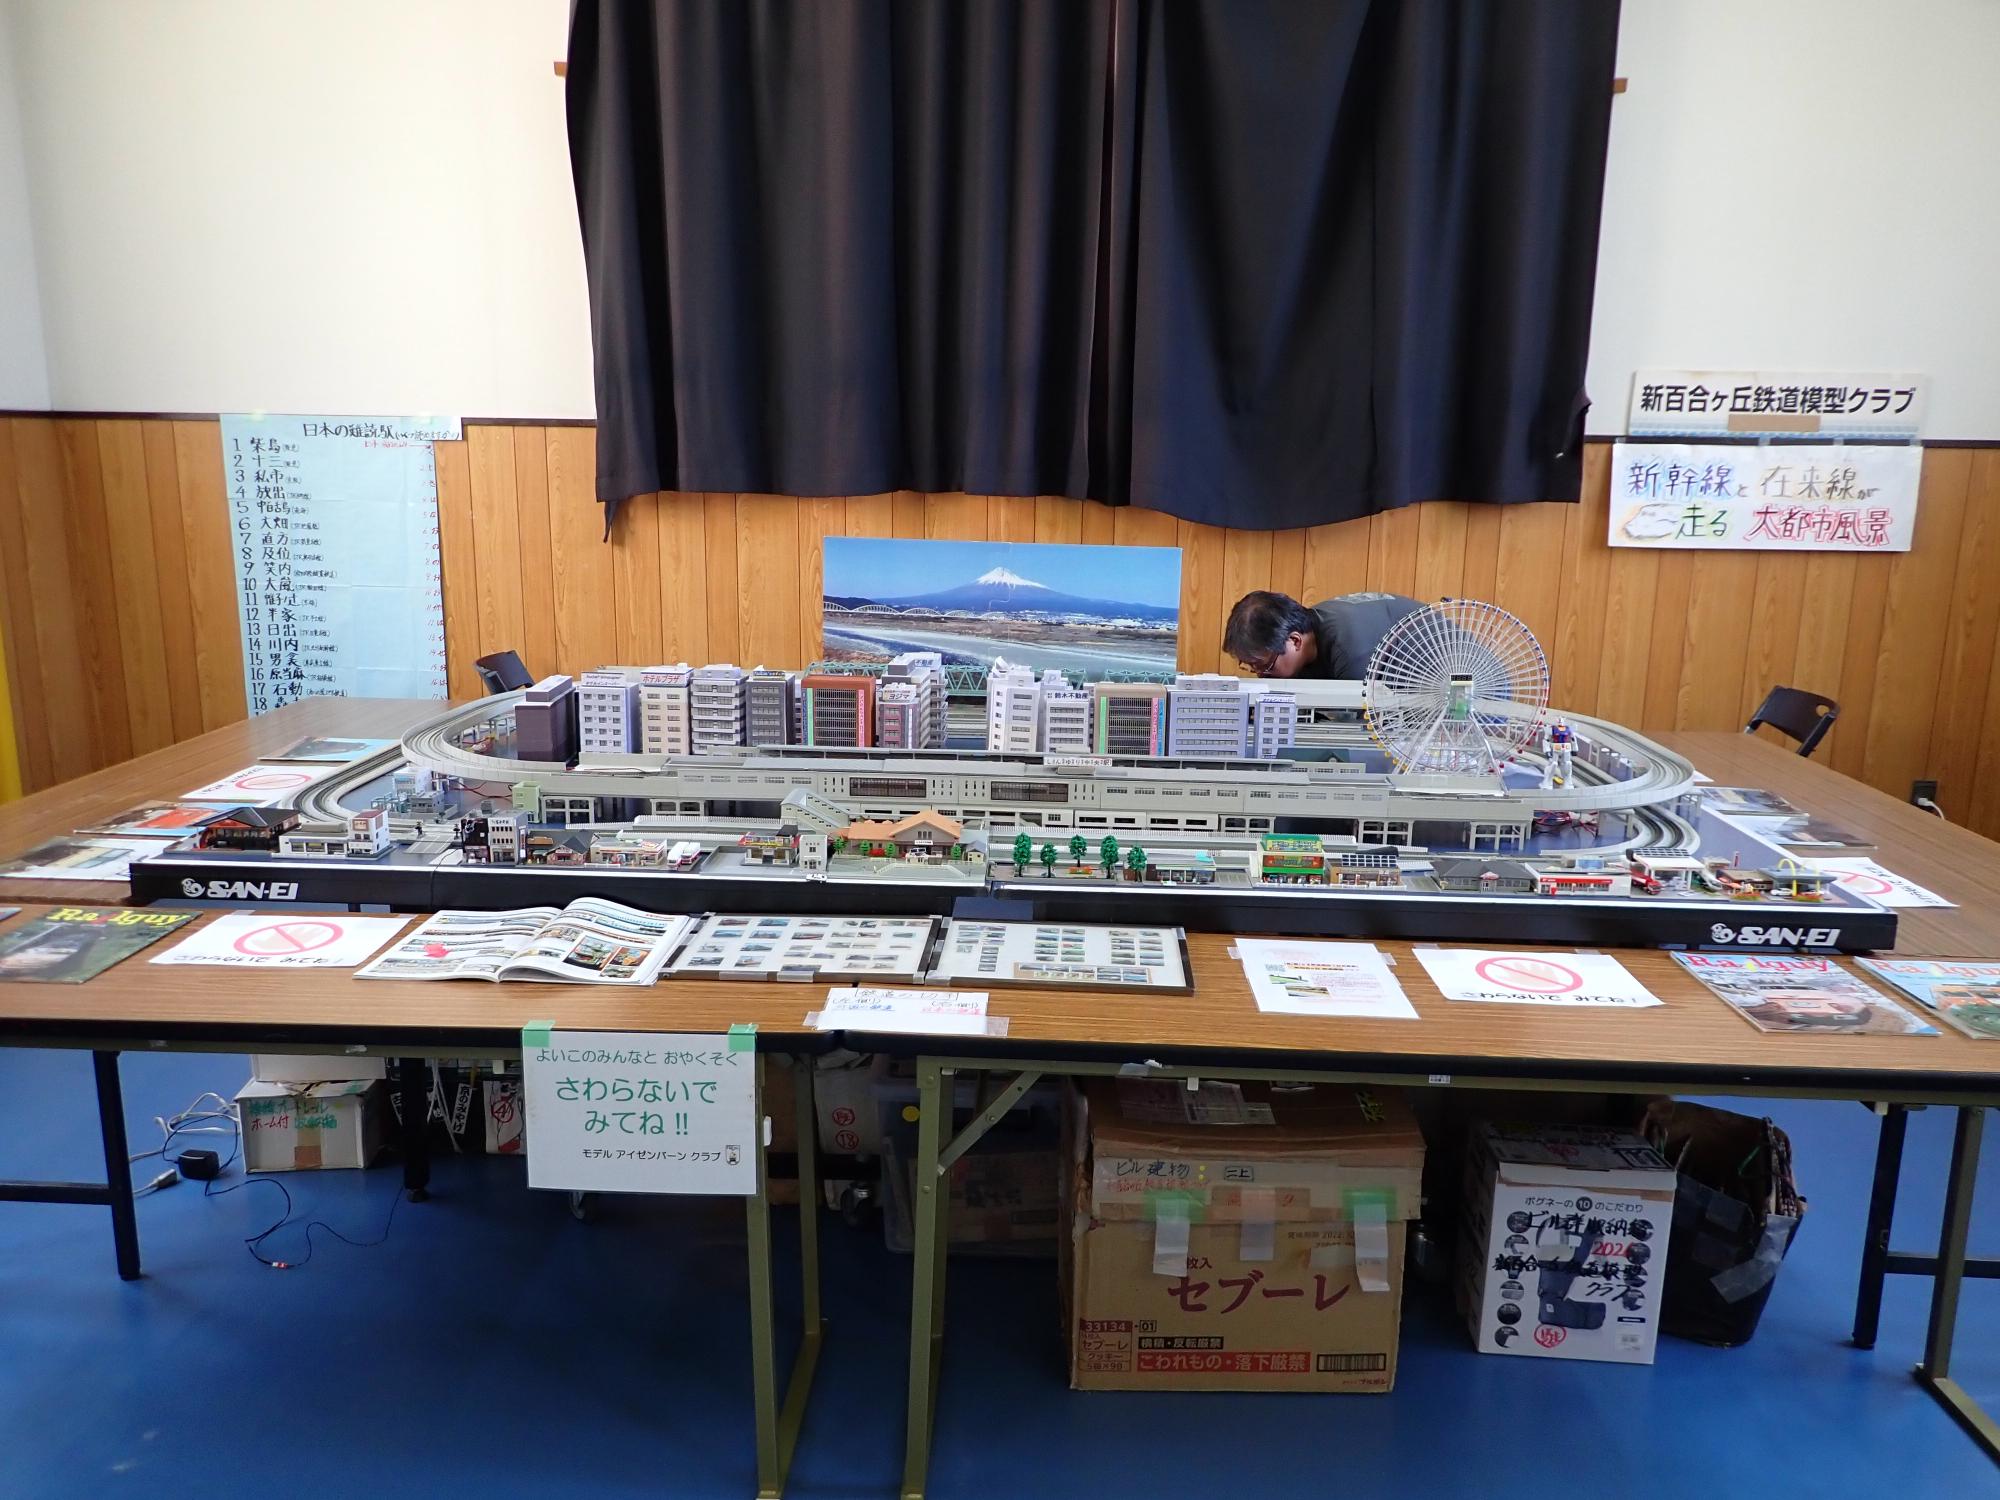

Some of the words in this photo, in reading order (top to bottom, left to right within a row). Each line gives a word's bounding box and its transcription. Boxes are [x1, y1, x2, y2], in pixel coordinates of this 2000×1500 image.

[1640, 383, 1916, 414] 新百合ヶ丘鉄道模型クラブ
[233, 438, 241, 451] 1
[233, 454, 245, 467] 2
[235, 469, 245, 482] 3
[235, 486, 246, 498] 4
[236, 501, 249, 513] 5
[239, 517, 251, 530] 6
[1676, 503, 1729, 539] 走る
[1746, 506, 1890, 545] 大都市風景
[240, 532, 251, 545] 7
[242, 547, 252, 560] 8
[244, 562, 255, 575] 9
[244, 578, 256, 591] 10
[245, 593, 259, 606] 11
[246, 608, 259, 620] 12
[247, 623, 260, 636] 13
[248, 638, 262, 651] 14
[249, 653, 263, 665] 15
[250, 668, 264, 680] 16
[643, 674, 681, 684] ホテルプラザ
[252, 683, 266, 695] 17
[253, 697, 267, 710] 18
[207, 879, 299, 900] SAN-EI
[1737, 926, 1841, 946] SAN-EI
[536, 1049, 657, 1064] よいこのみんなと
[664, 1050, 738, 1066] おやくそく
[555, 1076, 717, 1104] さわらないで
[582, 1149, 613, 1159] モデル
[616, 1149, 687, 1162] アイゼンバーン
[691, 1151, 721, 1162] クラブ
[1168, 1269, 1349, 1314] セブーレ
[1085, 1321, 1126, 1332] 33134
[1139, 1352, 1308, 1371] こわれもの・落下厳禁
